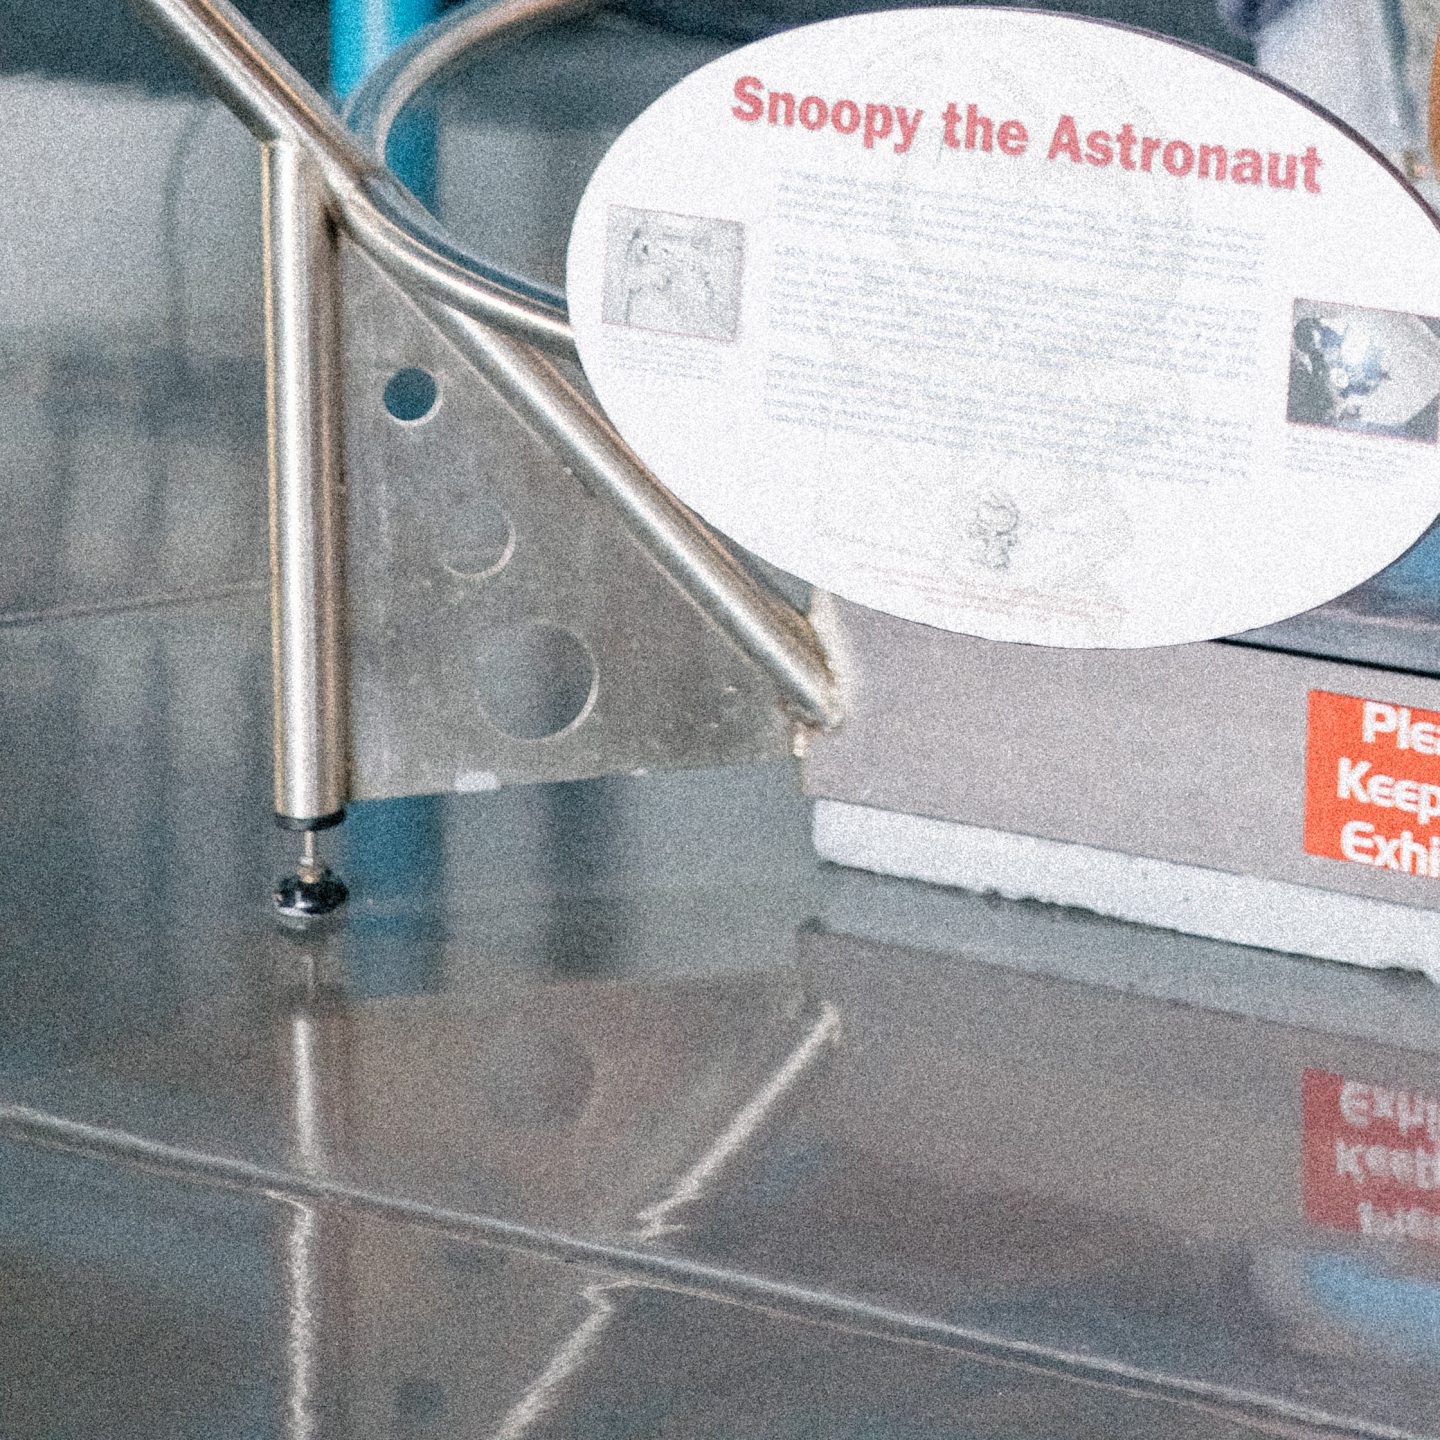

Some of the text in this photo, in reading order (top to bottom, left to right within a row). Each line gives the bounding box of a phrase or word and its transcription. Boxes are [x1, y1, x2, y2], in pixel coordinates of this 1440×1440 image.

[732, 76, 1320, 192] Snoopy the Astronaut
